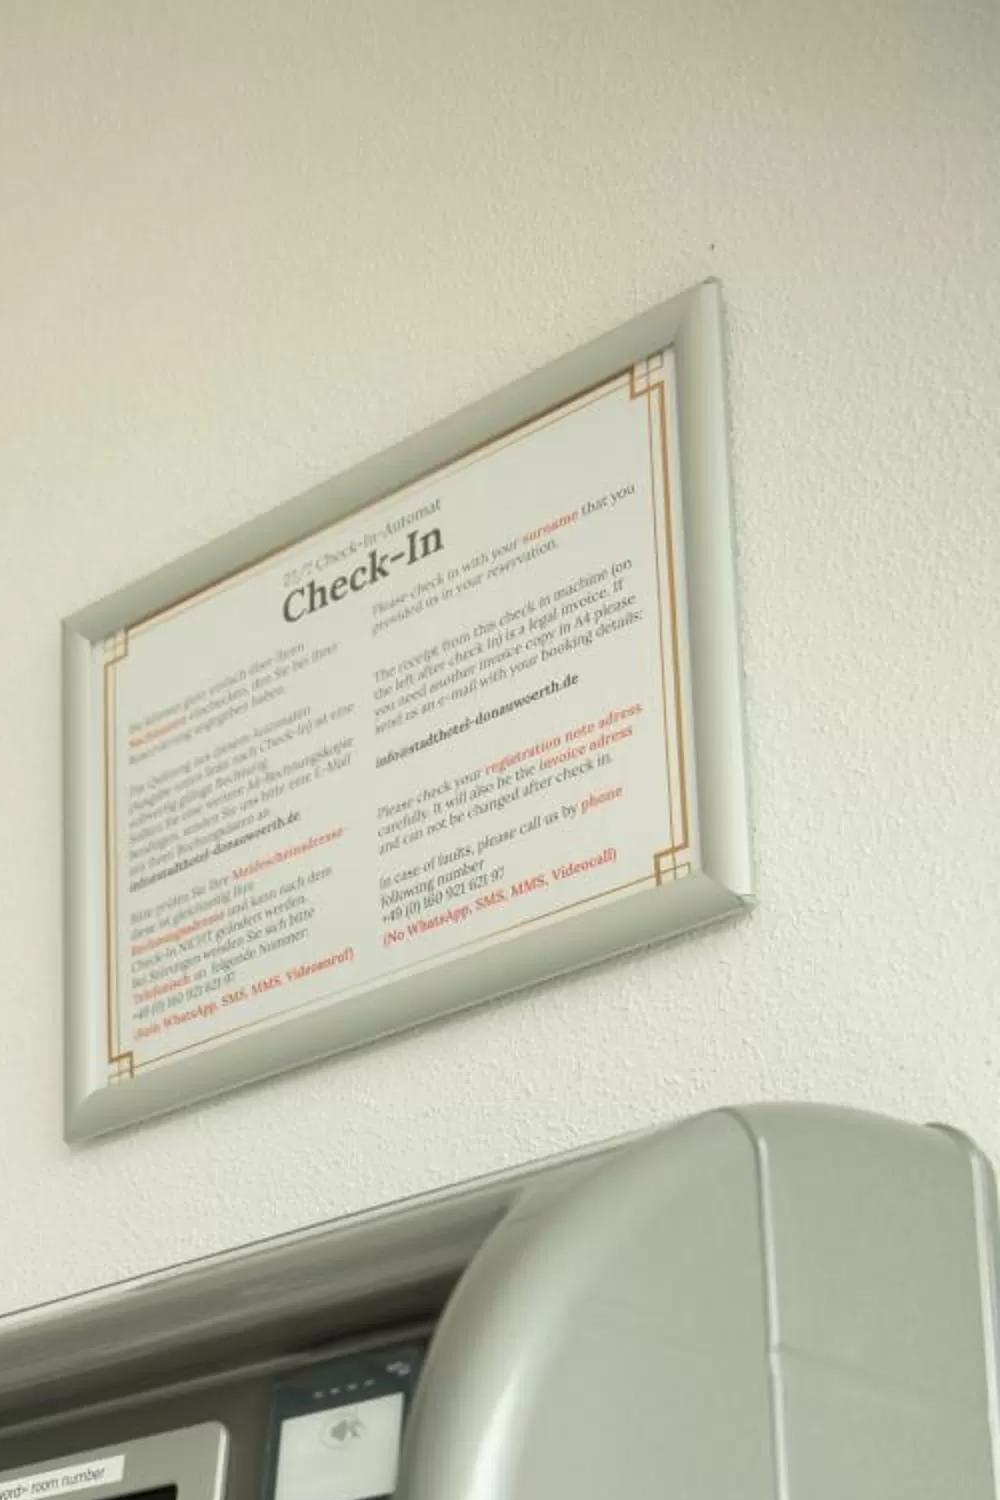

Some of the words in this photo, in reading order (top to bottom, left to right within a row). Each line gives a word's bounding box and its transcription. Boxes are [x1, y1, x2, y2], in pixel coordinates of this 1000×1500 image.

[282, 527, 443, 623] Check-In
[372, 591, 409, 615] Please
[410, 570, 446, 597] check
[447, 566, 461, 580] in
[462, 549, 490, 573] with
[492, 538, 521, 562] your
[522, 510, 580, 544] surname
[582, 494, 609, 516] that
[610, 484, 636, 506] you
[373, 684, 393, 700] the
[394, 672, 415, 691] left
[415, 661, 444, 682] after
[445, 641, 482, 668] check
[502, 629, 514, 642] is
[515, 626, 524, 637] a
[525, 607, 557, 632] legal
[558, 589, 610, 618] invoice.
[611, 577, 624, 594] If
[374, 664, 397, 682] The
[398, 643, 440, 671] receipt
[440, 631, 471, 652] from
[472, 619, 496, 638] this
[497, 599, 534, 627] check
[536, 596, 550, 609] in
[551, 570, 608, 602] machine
[609, 559, 632, 579] (on
[374, 700, 396, 720] you
[397, 683, 427, 706] need
[428, 664, 477, 693] another
[524, 630, 556, 650] copy
[557, 622, 572, 636] in
[573, 611, 591, 628] A4
[593, 593, 636, 623] please
[404, 708, 419, 722] us
[420, 700, 437, 715] an
[438, 679, 477, 707] e-mail
[478, 666, 507, 689] with
[508, 656, 538, 680] your
[539, 632, 593, 662] booking
[594, 610, 643, 638] details:
[377, 797, 415, 819] Please
[416, 778, 453, 804] check
[453, 769, 482, 792] your
[484, 737, 561, 776] registration
[564, 723, 594, 743] note
[597, 702, 644, 730] adress
[378, 834, 401, 854] and
[402, 828, 425, 845] can
[426, 817, 447, 835] not
[448, 812, 464, 826] be
[465, 787, 518, 819] changed
[520, 778, 551, 798] after
[552, 758, 591, 785] check
[432, 802, 441, 815] It
[444, 790, 467, 810] will
[468, 782, 495, 800] also
[496, 774, 514, 789] be
[514, 765, 536, 782] the
[538, 746, 585, 772] invoice
[588, 726, 633, 752] adress
[379, 876, 393, 889] In
[394, 865, 421, 883] case
[422, 855, 437, 872] of
[437, 845, 476, 866] faults,
[477, 828, 517, 854] please
[518, 814, 542, 835] call
[543, 811, 559, 825] us
[560, 803, 578, 819] by
[579, 786, 623, 814] phone
[380, 879, 435, 907] following
[436, 859, 485, 885] number
[509, 875, 548, 898] MMS,
[30, 1479, 59, 1495] room
[61, 1466, 106, 1490] number
